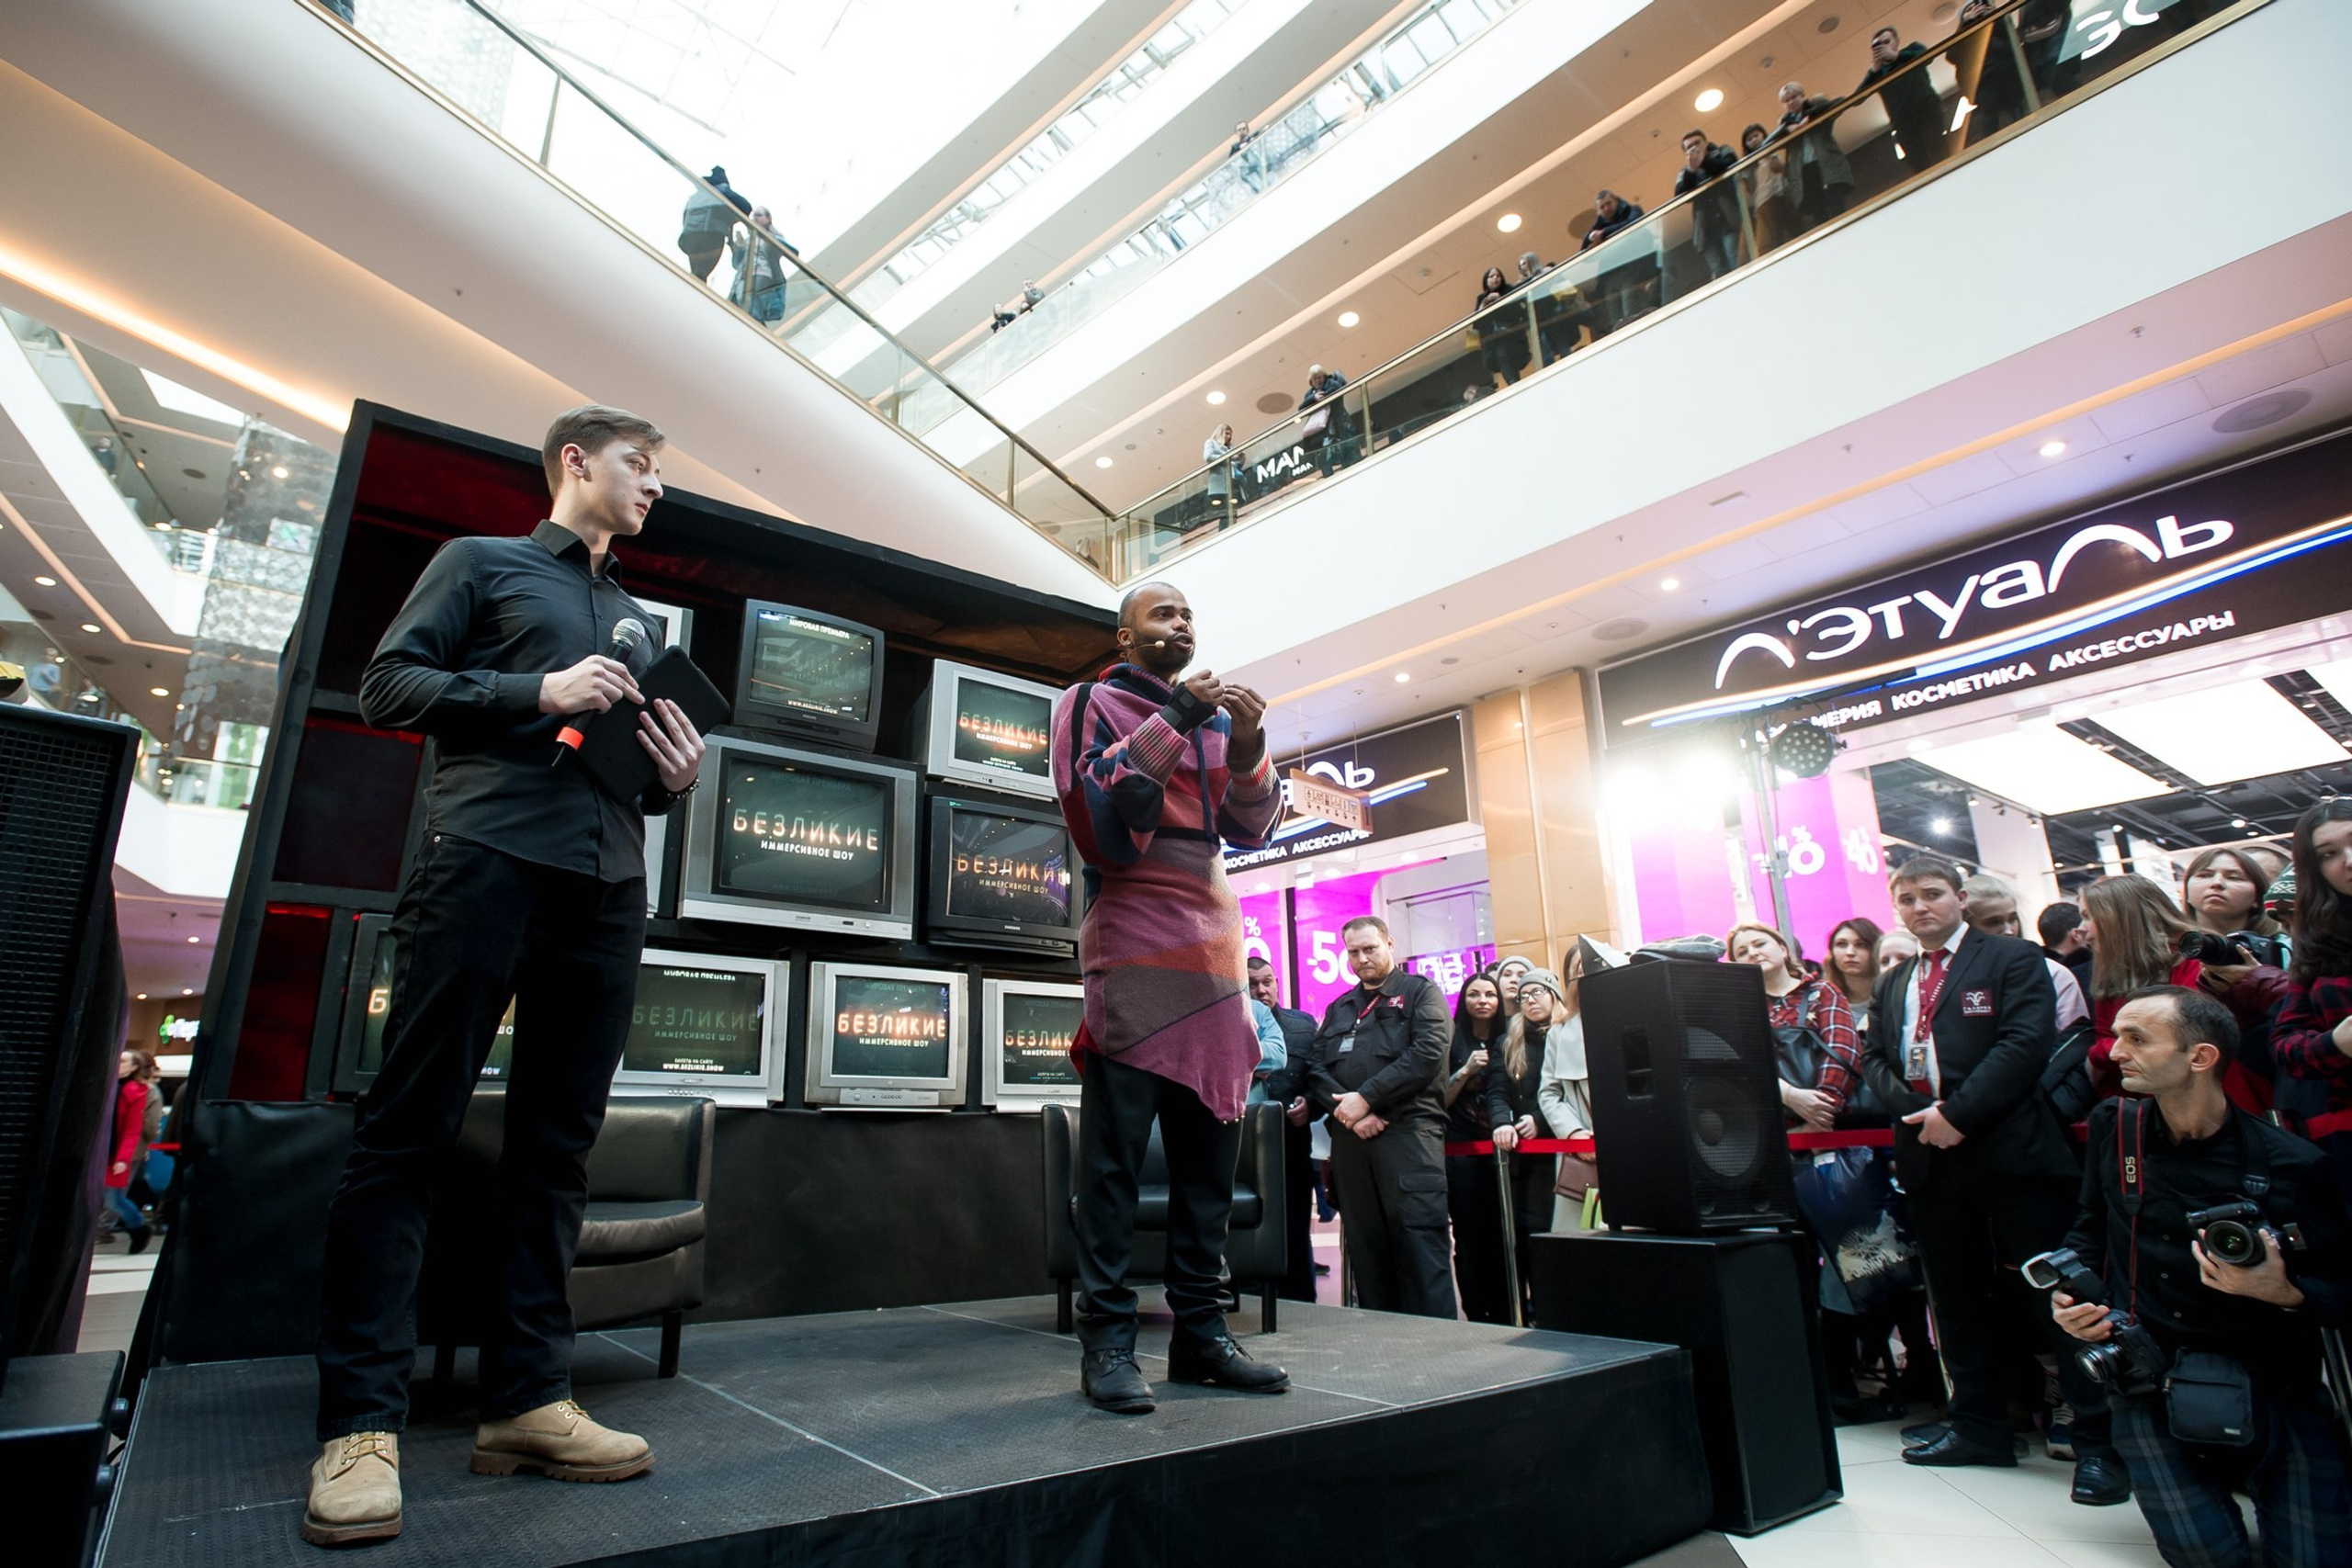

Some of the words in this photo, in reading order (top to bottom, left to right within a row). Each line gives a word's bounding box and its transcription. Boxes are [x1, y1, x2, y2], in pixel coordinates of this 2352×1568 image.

[1891, 661, 2037, 712] КОСМЕТИКА
[2048, 610, 2236, 671] АКСЕССУАРЫ
[958, 711, 1047, 745] БЕЗЛИКИЕ
[733, 808, 878, 851] БЕЗЛИКИЕ
[1292, 829, 1370, 855] АКСЕССУАРЫ
[761, 840, 831, 858] ИММЕРСИВНОЕ
[832, 850, 855, 861] ШОУ
[978, 878, 1031, 892] ИММЕРСИВНОЕ
[1033, 885, 1049, 895] ШОУ
[632, 1005, 758, 1032] БЕЗЛИКИЕ
[837, 1012, 946, 1038] БЕЗЛИКИЕ
[654, 1030, 716, 1041] ИММЕРСИВНОЕ
[718, 1033, 737, 1043] ШОУ
[859, 1037, 911, 1047] ИММЕРСИВНОЕ
[913, 1039, 930, 1048] ШОУ
[1004, 1029, 1073, 1048] БЕЗЛИК
[2124, 1156, 2137, 1184] EOS
